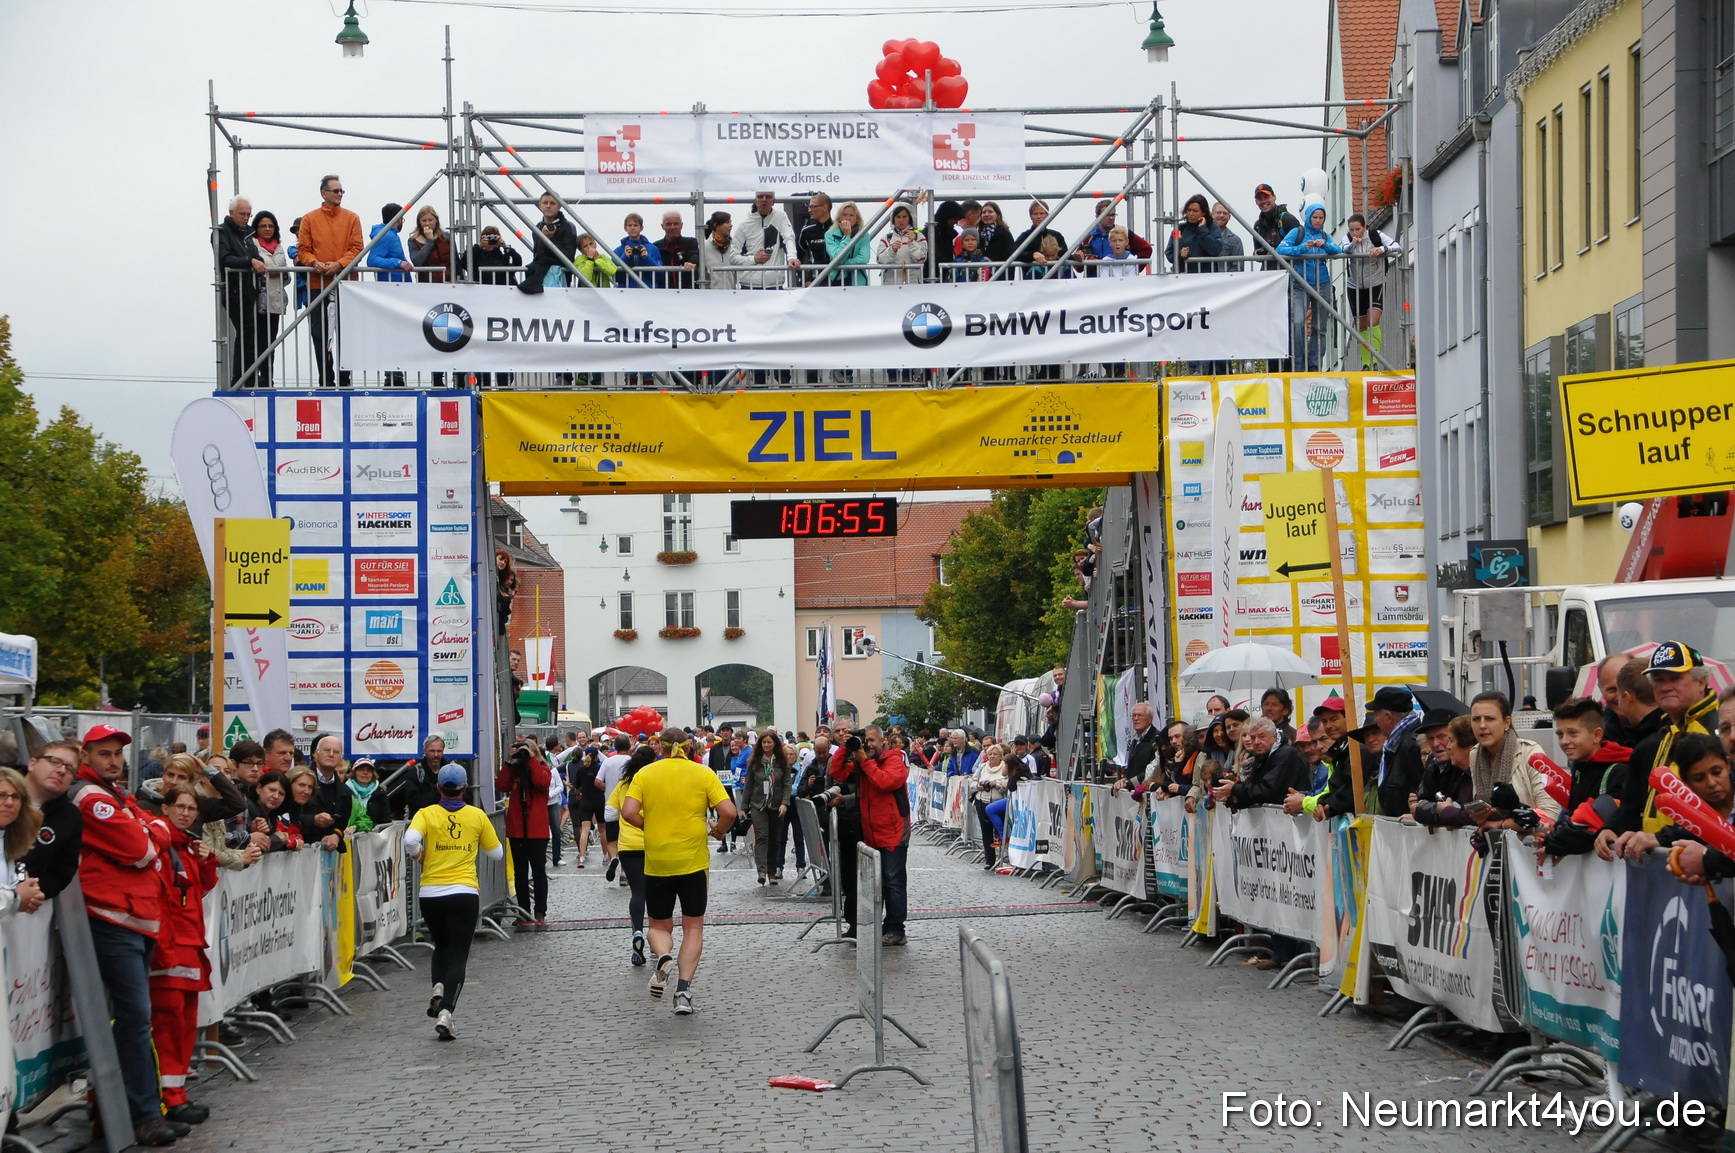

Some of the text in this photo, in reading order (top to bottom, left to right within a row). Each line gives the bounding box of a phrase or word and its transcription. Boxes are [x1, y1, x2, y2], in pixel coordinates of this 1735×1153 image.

[717, 122, 880, 140] LEBENSSPENDER
[599, 160, 634, 172] DKMS
[754, 150, 842, 168] WERDEN!
[935, 158, 968, 170] DKMS
[658, 176, 678, 184] ZÄHLT
[758, 172, 840, 184] www.dkms.de
[427, 303, 470, 322] BMW
[906, 303, 949, 320] BMW
[964, 306, 1210, 338] BMW Laufsport
[486, 316, 737, 348] BMW Laufsport
[1172, 391, 1207, 402] Xplus1
[1307, 382, 1335, 400] RUND
[1238, 407, 1266, 416] KANN
[1308, 400, 1339, 415] SCHAU
[440, 420, 458, 429] Braun
[1577, 402, 1734, 436] Schnupper
[296, 421, 320, 432] Braun
[748, 410, 897, 462] ZIEL
[979, 431, 1124, 447] Neumarkter Stadtlauf
[519, 441, 664, 454] Neumarkter Stadtlauf
[1638, 436, 1692, 465] lauf
[1389, 453, 1407, 463] DEHN
[356, 464, 411, 481] Xplus1
[1185, 484, 1200, 493] maxi
[1371, 493, 1421, 509] Xplus1
[298, 520, 338, 529] Bionorica
[358, 520, 412, 529] HACKNER
[780, 502, 885, 534] 1:06:55
[1286, 519, 1317, 538] lauf
[1177, 550, 1212, 560] NATHUS
[1240, 549, 1266, 560] wn
[377, 560, 392, 569] FÜR
[394, 561, 409, 569] SIE!
[1489, 556, 1510, 580] G2
[238, 568, 270, 585] lauf
[296, 583, 325, 591] KANN
[369, 614, 399, 629] maxi
[1377, 612, 1424, 621] Lammsbräu
[386, 635, 399, 645] dsl
[431, 631, 470, 645] Charivari
[355, 722, 415, 742] Charivari
[435, 842, 462, 852] Neunkirchen
